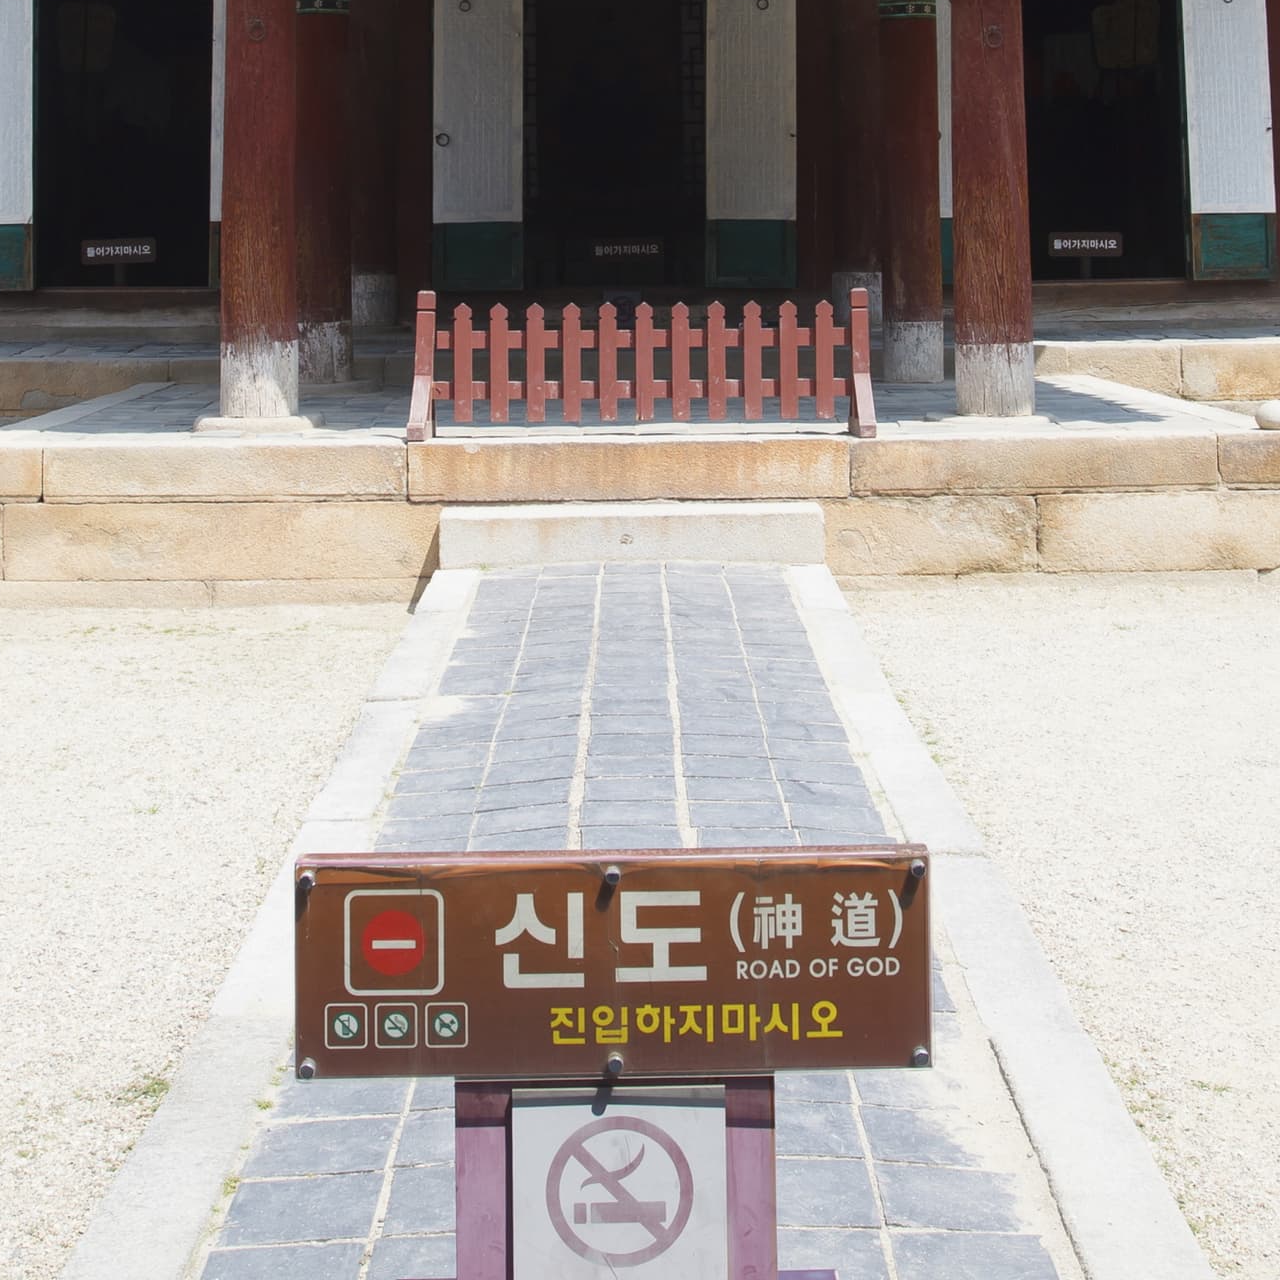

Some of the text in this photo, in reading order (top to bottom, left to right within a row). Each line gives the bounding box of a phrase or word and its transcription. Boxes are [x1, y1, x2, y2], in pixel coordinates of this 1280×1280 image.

[495, 891, 708, 988] 신도
[736, 957, 900, 980] ROAD OF GOD
[550, 1001, 843, 1045] 진입하지마시오
